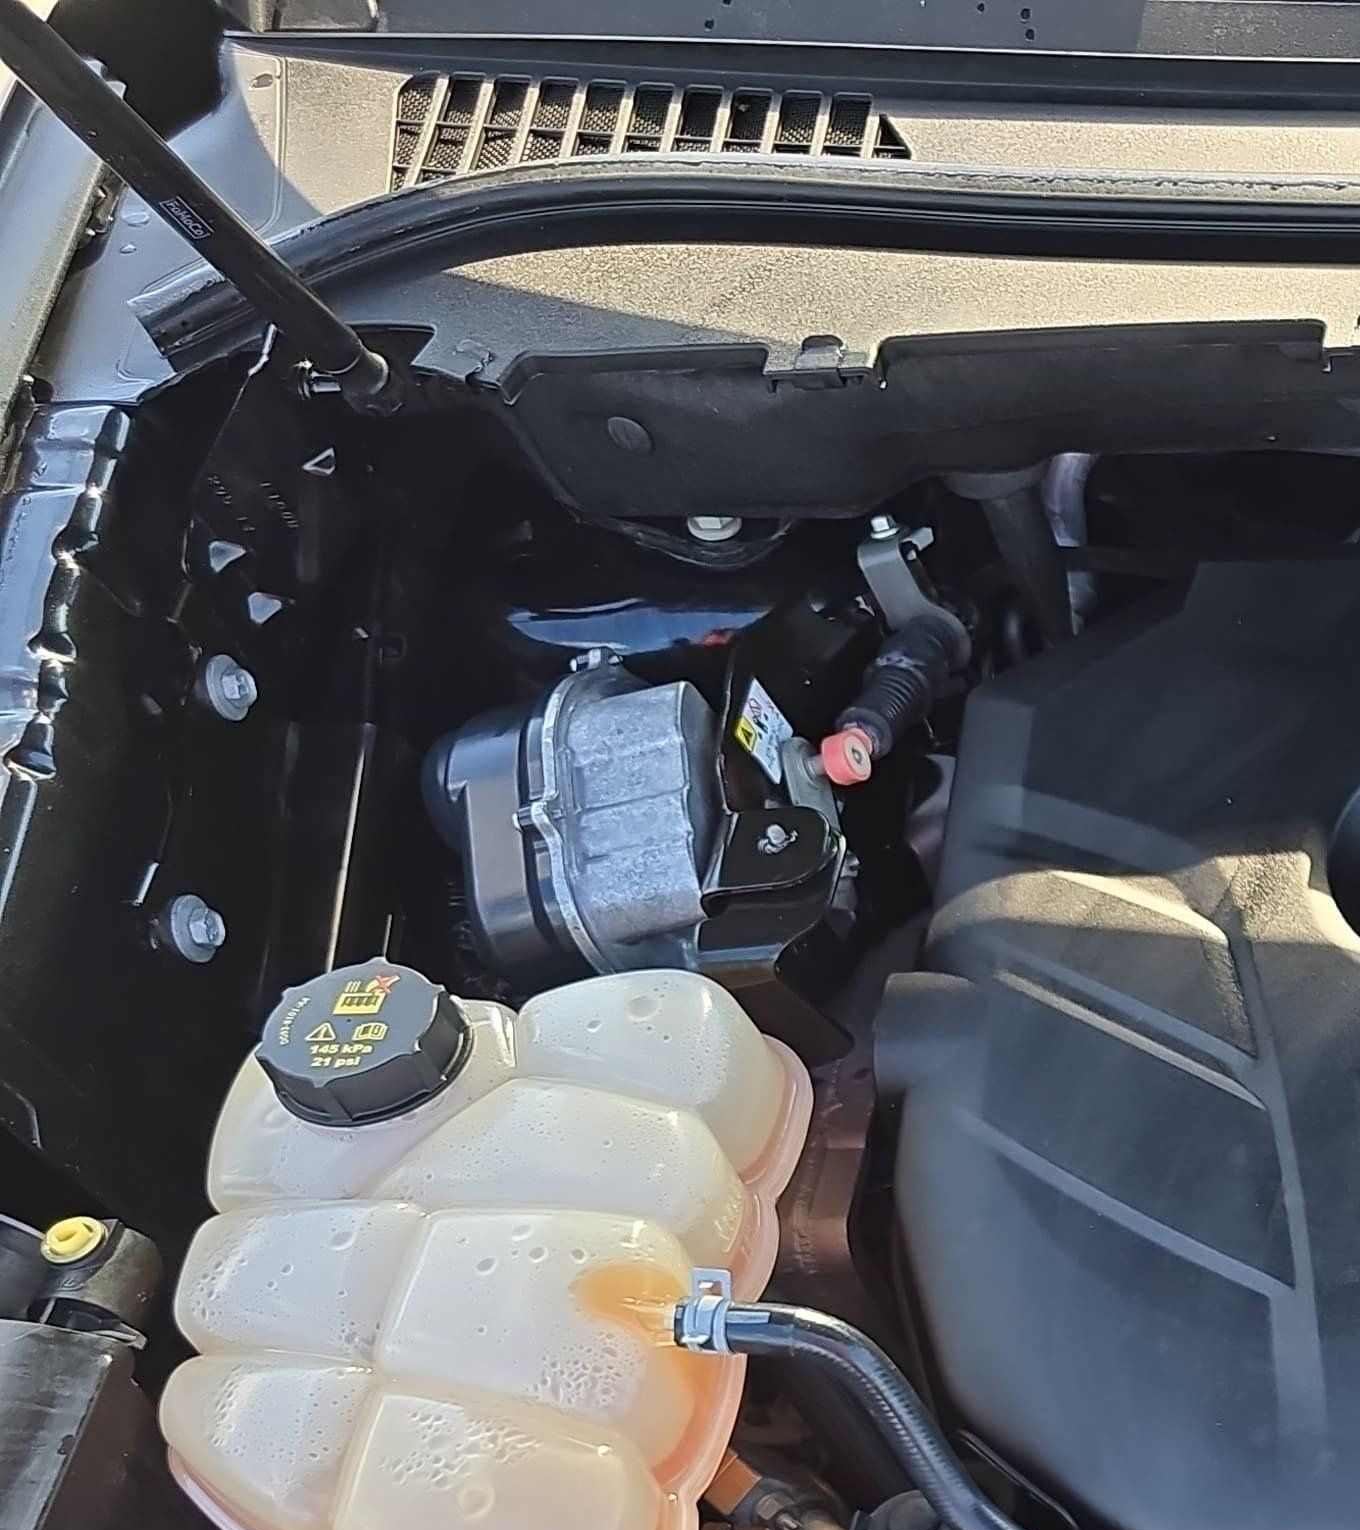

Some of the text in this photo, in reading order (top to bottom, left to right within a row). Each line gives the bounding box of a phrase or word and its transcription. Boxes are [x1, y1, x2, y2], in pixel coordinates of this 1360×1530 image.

[310, 1043, 374, 1054] 145 kPa
[311, 1056, 361, 1069] 21 psi
